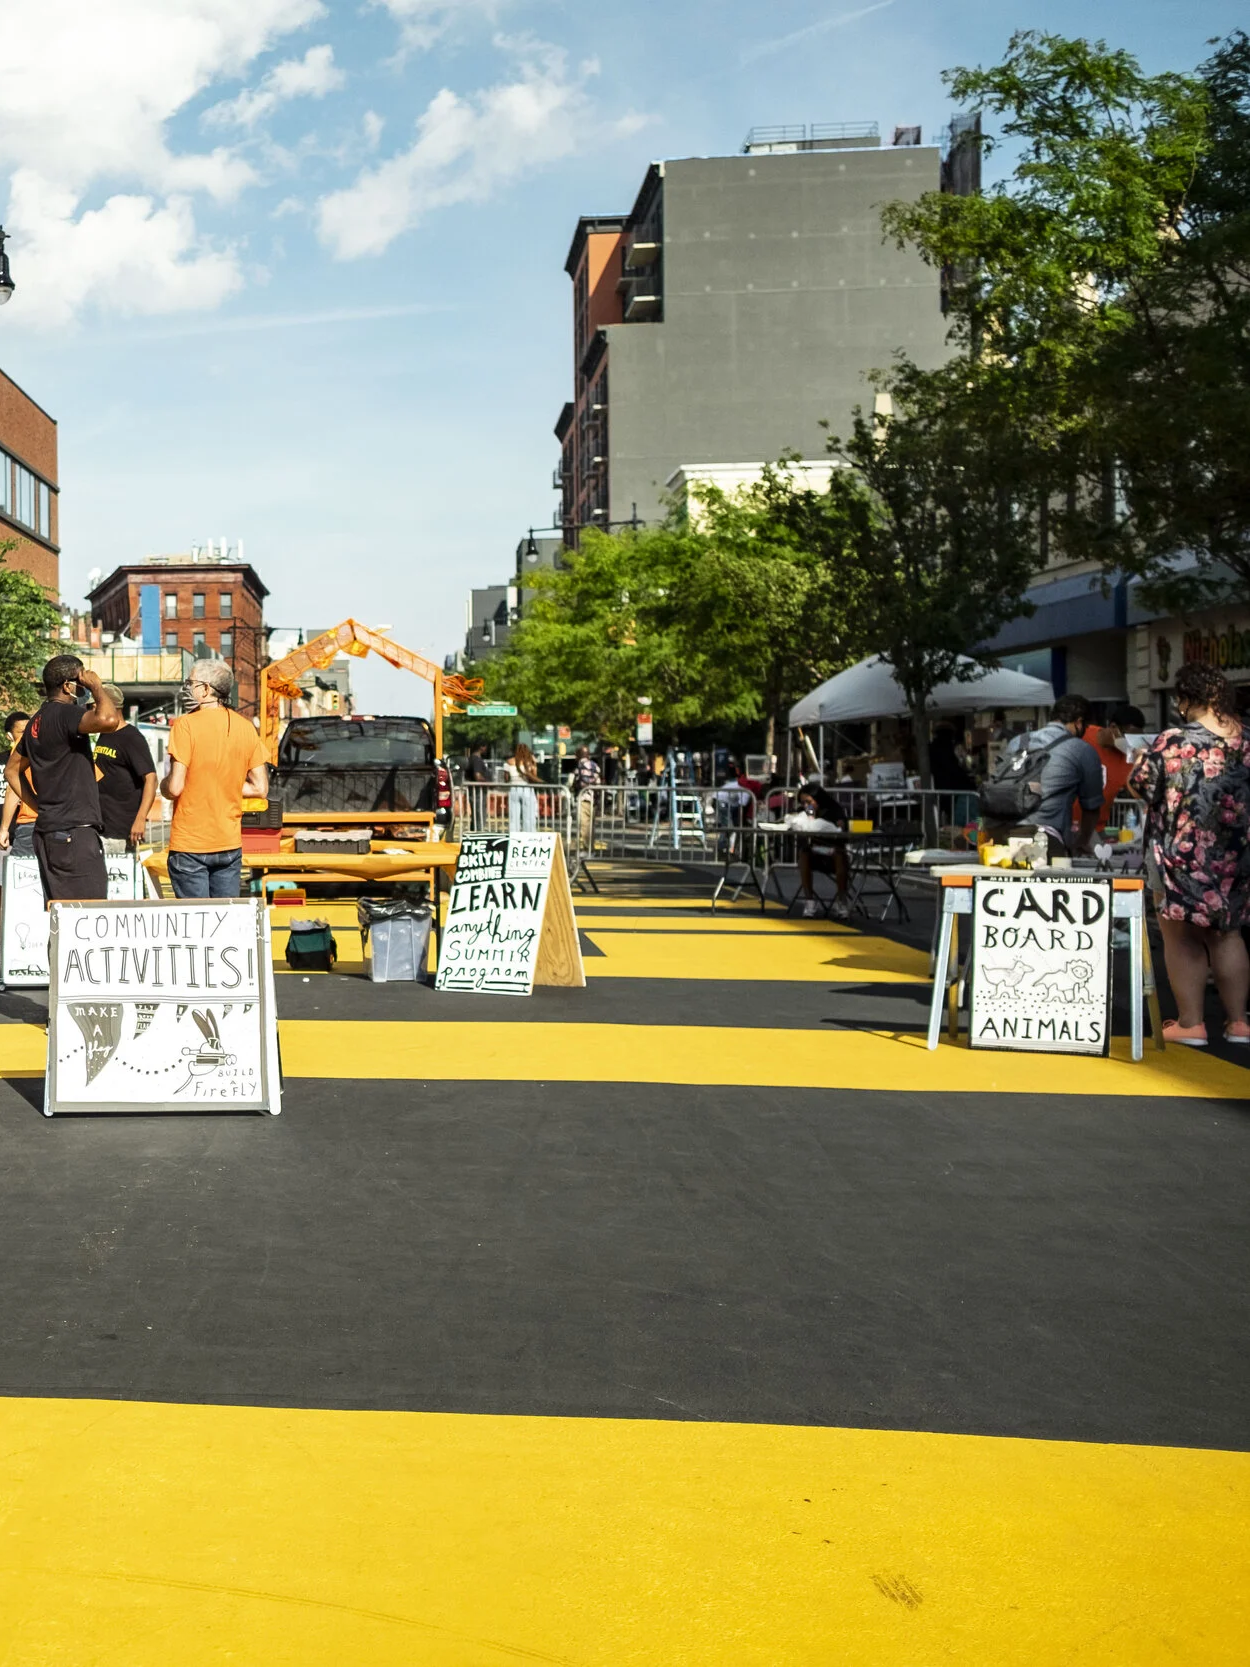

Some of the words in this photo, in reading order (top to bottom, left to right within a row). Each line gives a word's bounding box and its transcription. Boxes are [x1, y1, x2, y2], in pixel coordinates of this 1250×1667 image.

[462, 840, 488, 853] THE
[512, 846, 551, 860] BEAM
[450, 882, 542, 915] LEARN
[982, 888, 1105, 925] CARD
[74, 911, 229, 941] COMMUNITY
[447, 909, 538, 954] anything
[981, 925, 1094, 951] BOARD
[63, 944, 255, 989] ACTIVITIES!
[441, 966, 529, 989] program
[75, 1006, 119, 1018] MAKE
[92, 1024, 103, 1036] A
[979, 1017, 1102, 1042] ANIMALS
[87, 1041, 113, 1060] flag
